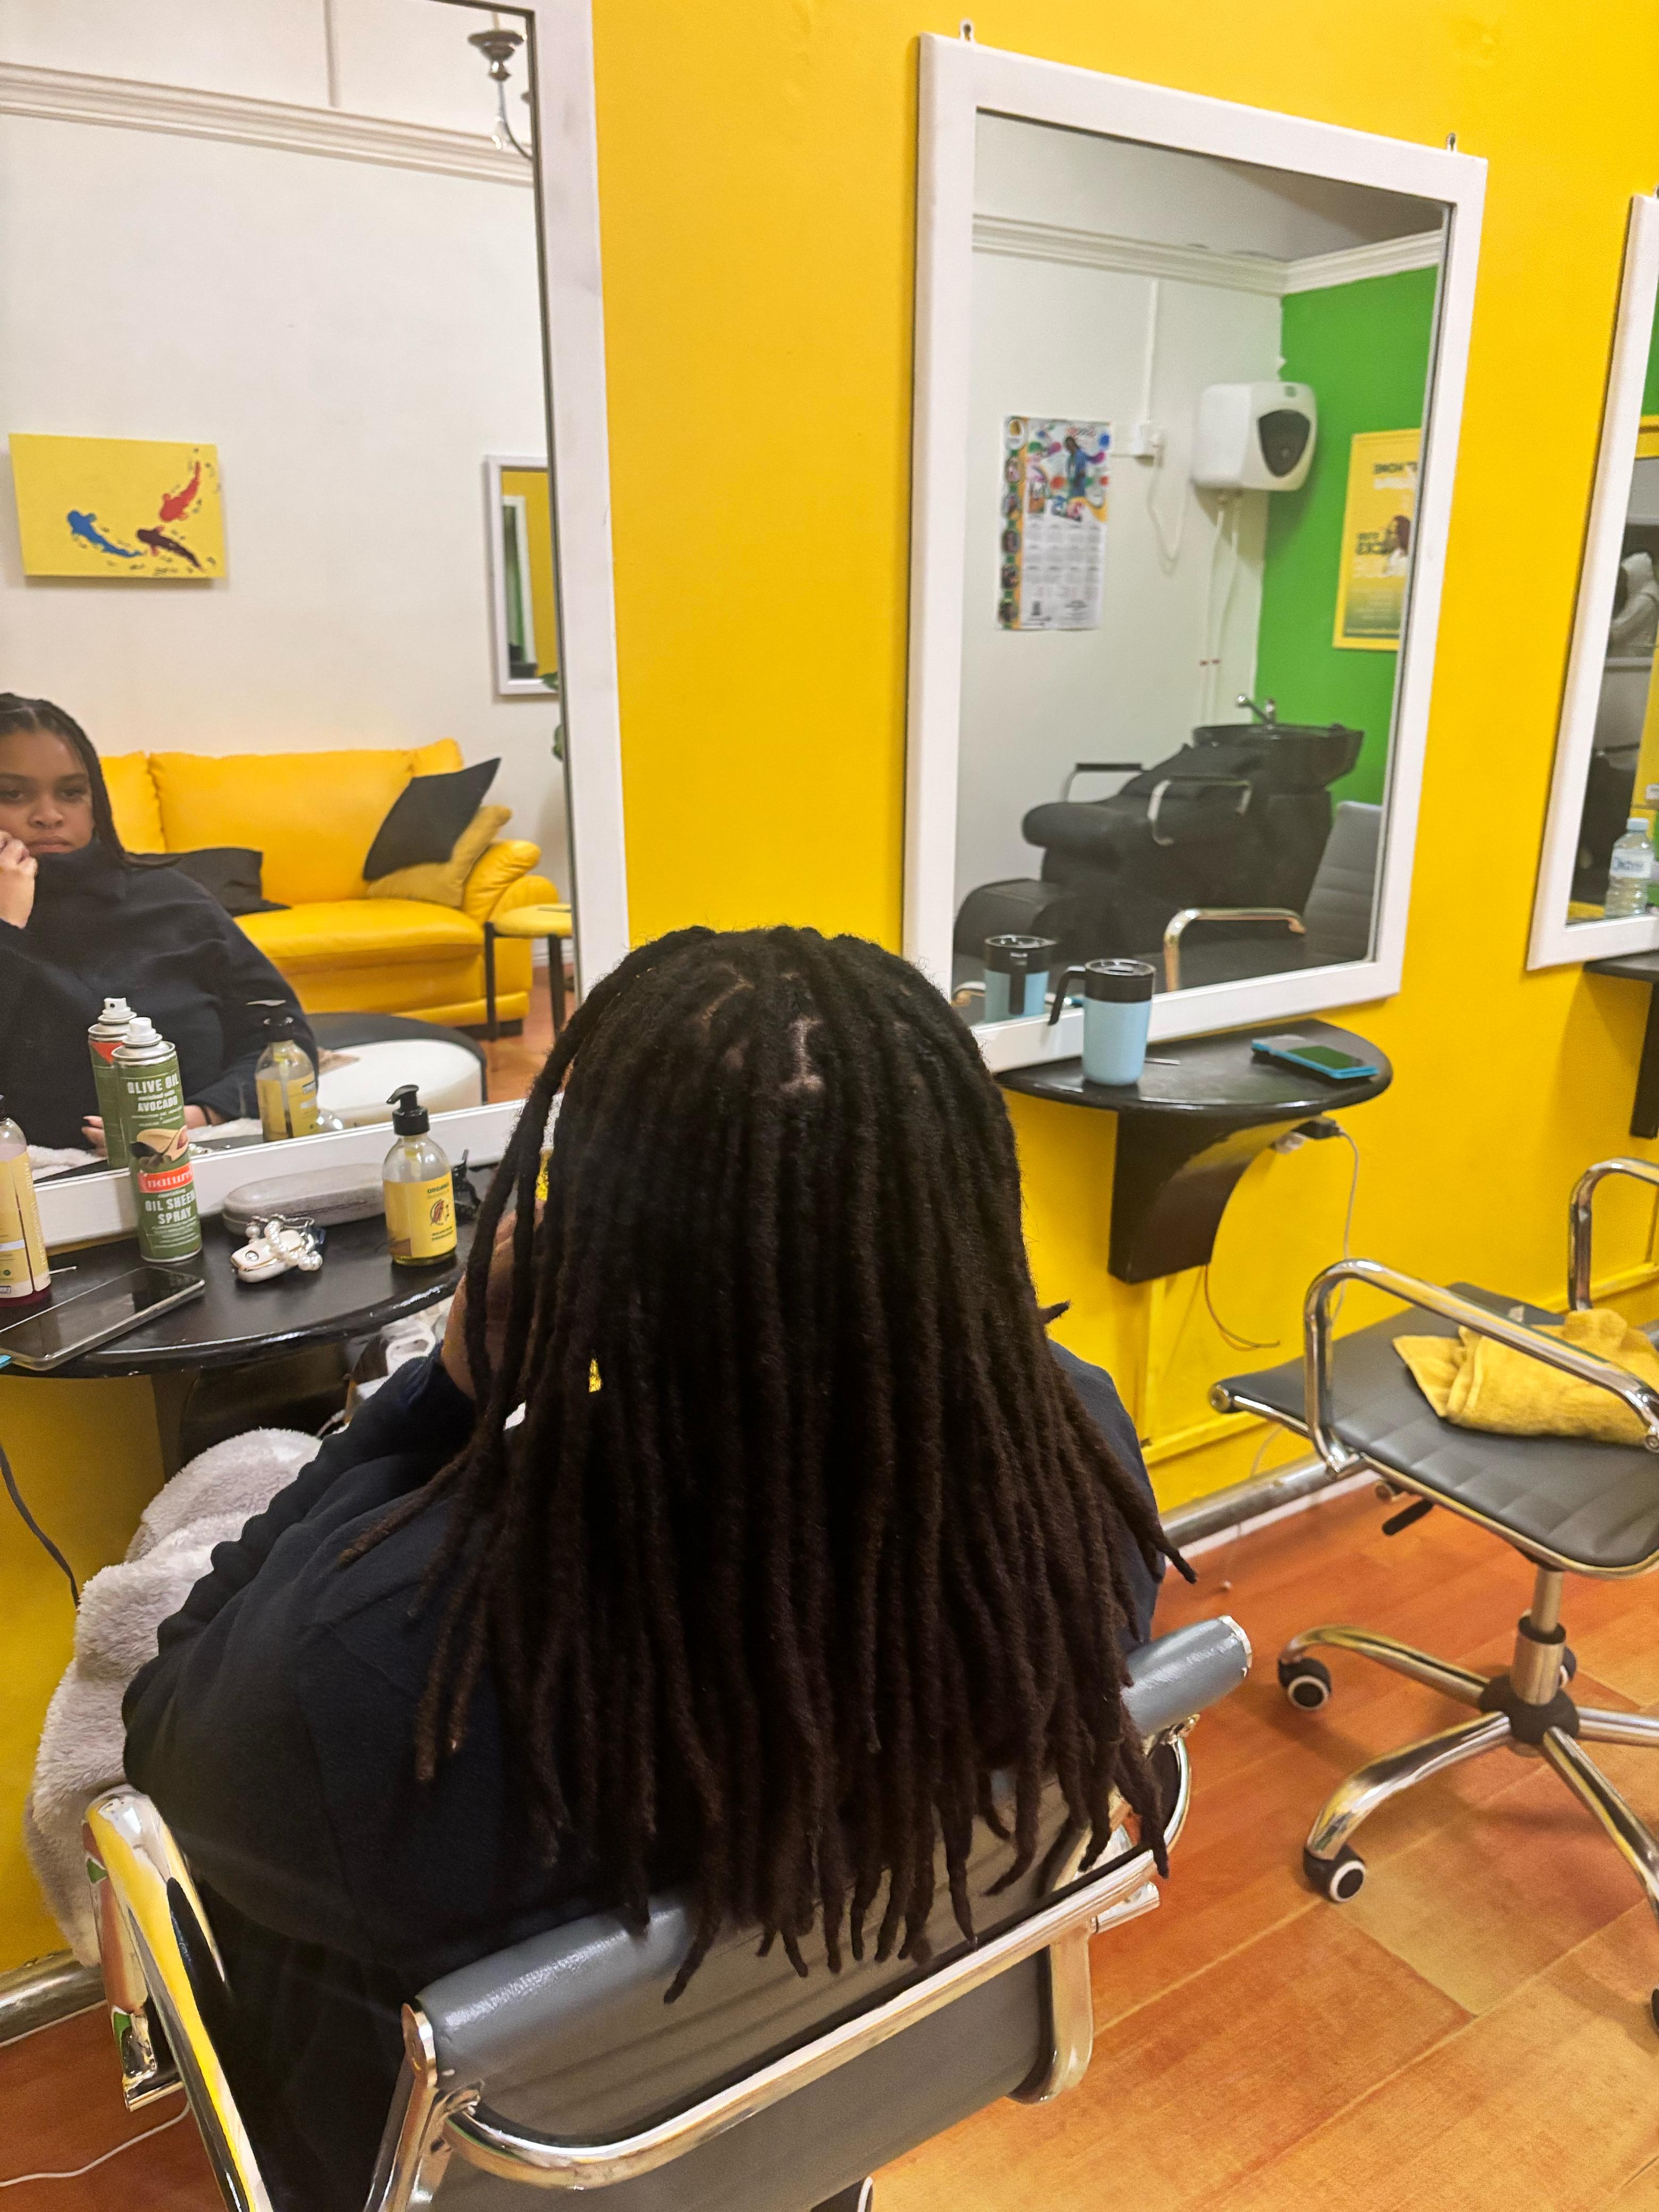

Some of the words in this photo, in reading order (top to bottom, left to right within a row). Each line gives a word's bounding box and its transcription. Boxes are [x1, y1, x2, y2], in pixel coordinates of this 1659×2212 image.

[128, 1079, 163, 1094] OLIVE
[165, 1073, 179, 1089] OIL
[138, 1095, 178, 1112] AVOCADO
[145, 1200, 164, 1212] OIL
[158, 1206, 191, 1225] SPRAY
